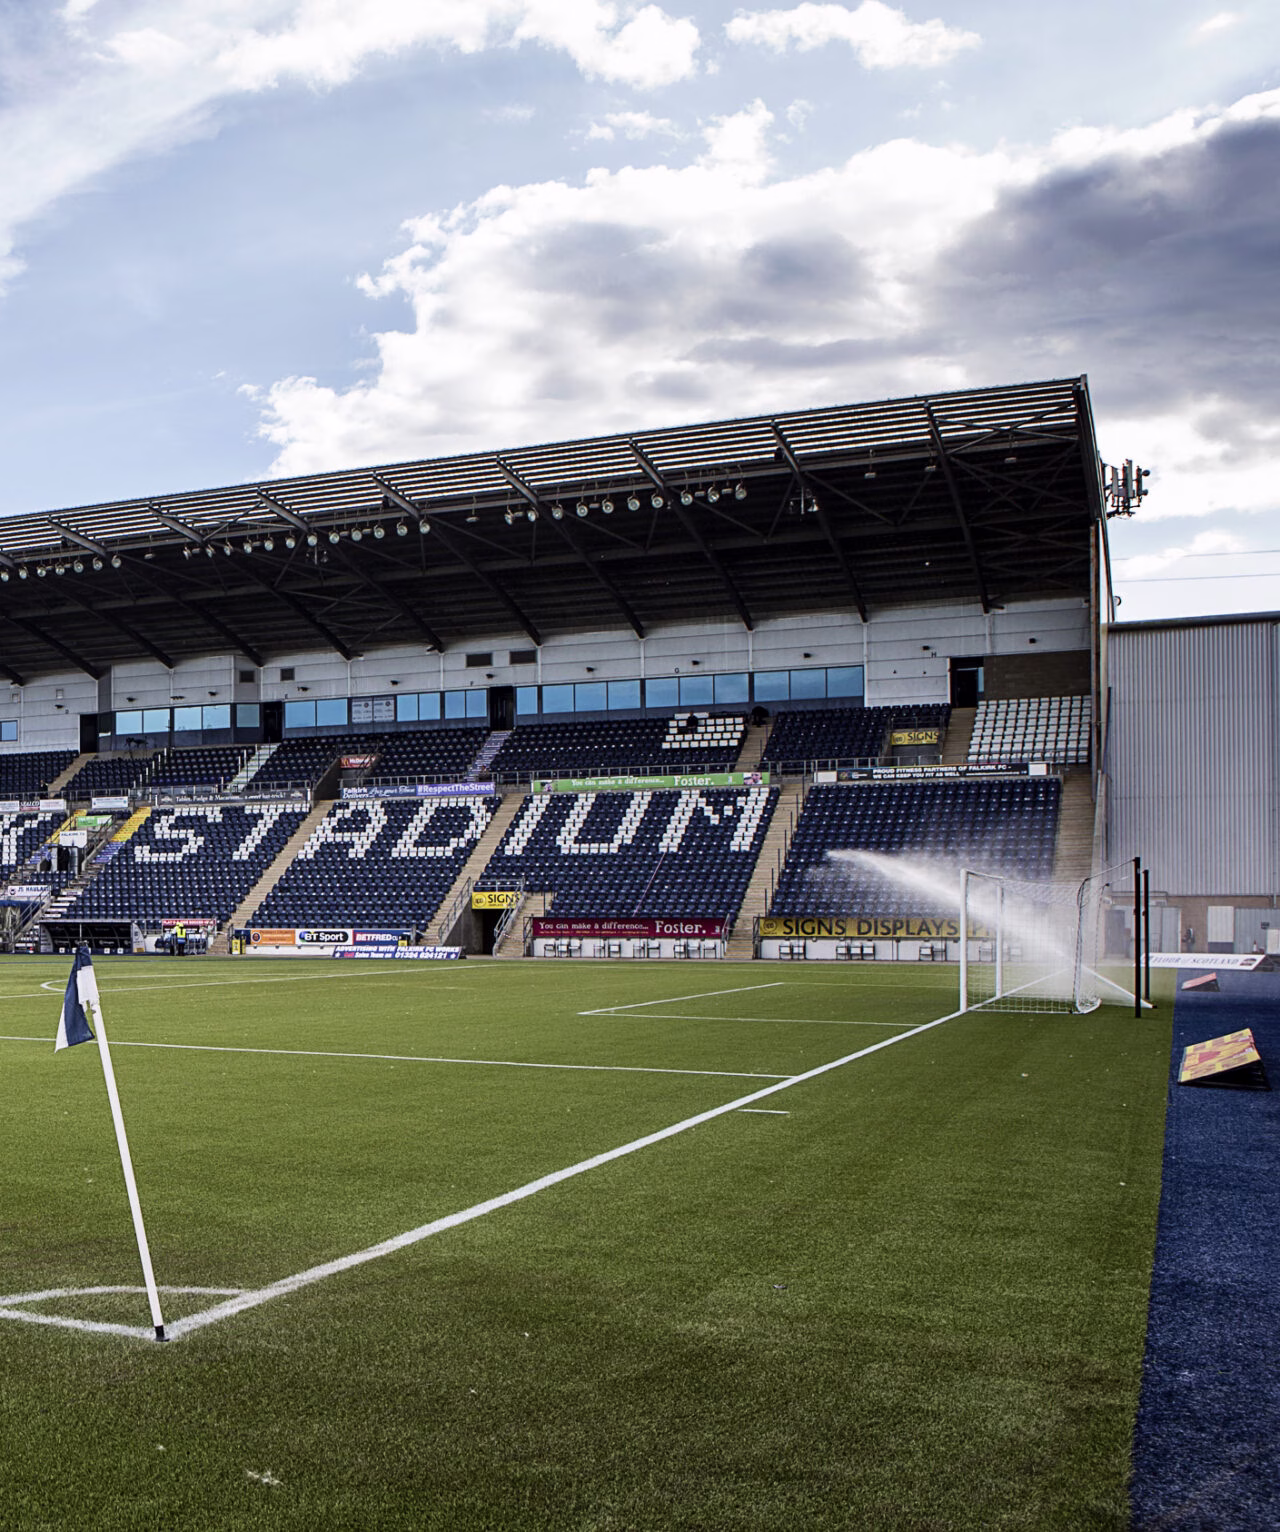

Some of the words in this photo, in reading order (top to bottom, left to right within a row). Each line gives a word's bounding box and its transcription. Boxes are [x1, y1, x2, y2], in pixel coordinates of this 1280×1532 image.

[673, 776, 715, 786] Foster.
[343, 786, 368, 794] Falkirk
[417, 783, 494, 794] #RespectTheStreet
[134, 787, 770, 862] STADIUM
[539, 921, 554, 930] You
[556, 922, 569, 930] can
[571, 922, 592, 930] make
[601, 921, 649, 930] difference...
[655, 920, 707, 934] Foster.
[783, 919, 846, 936] SIGNS
[856, 918, 959, 936] DISPLAYS
[304, 932, 319, 940] BT
[320, 932, 344, 942] Sport
[355, 933, 392, 941] BETFRED
